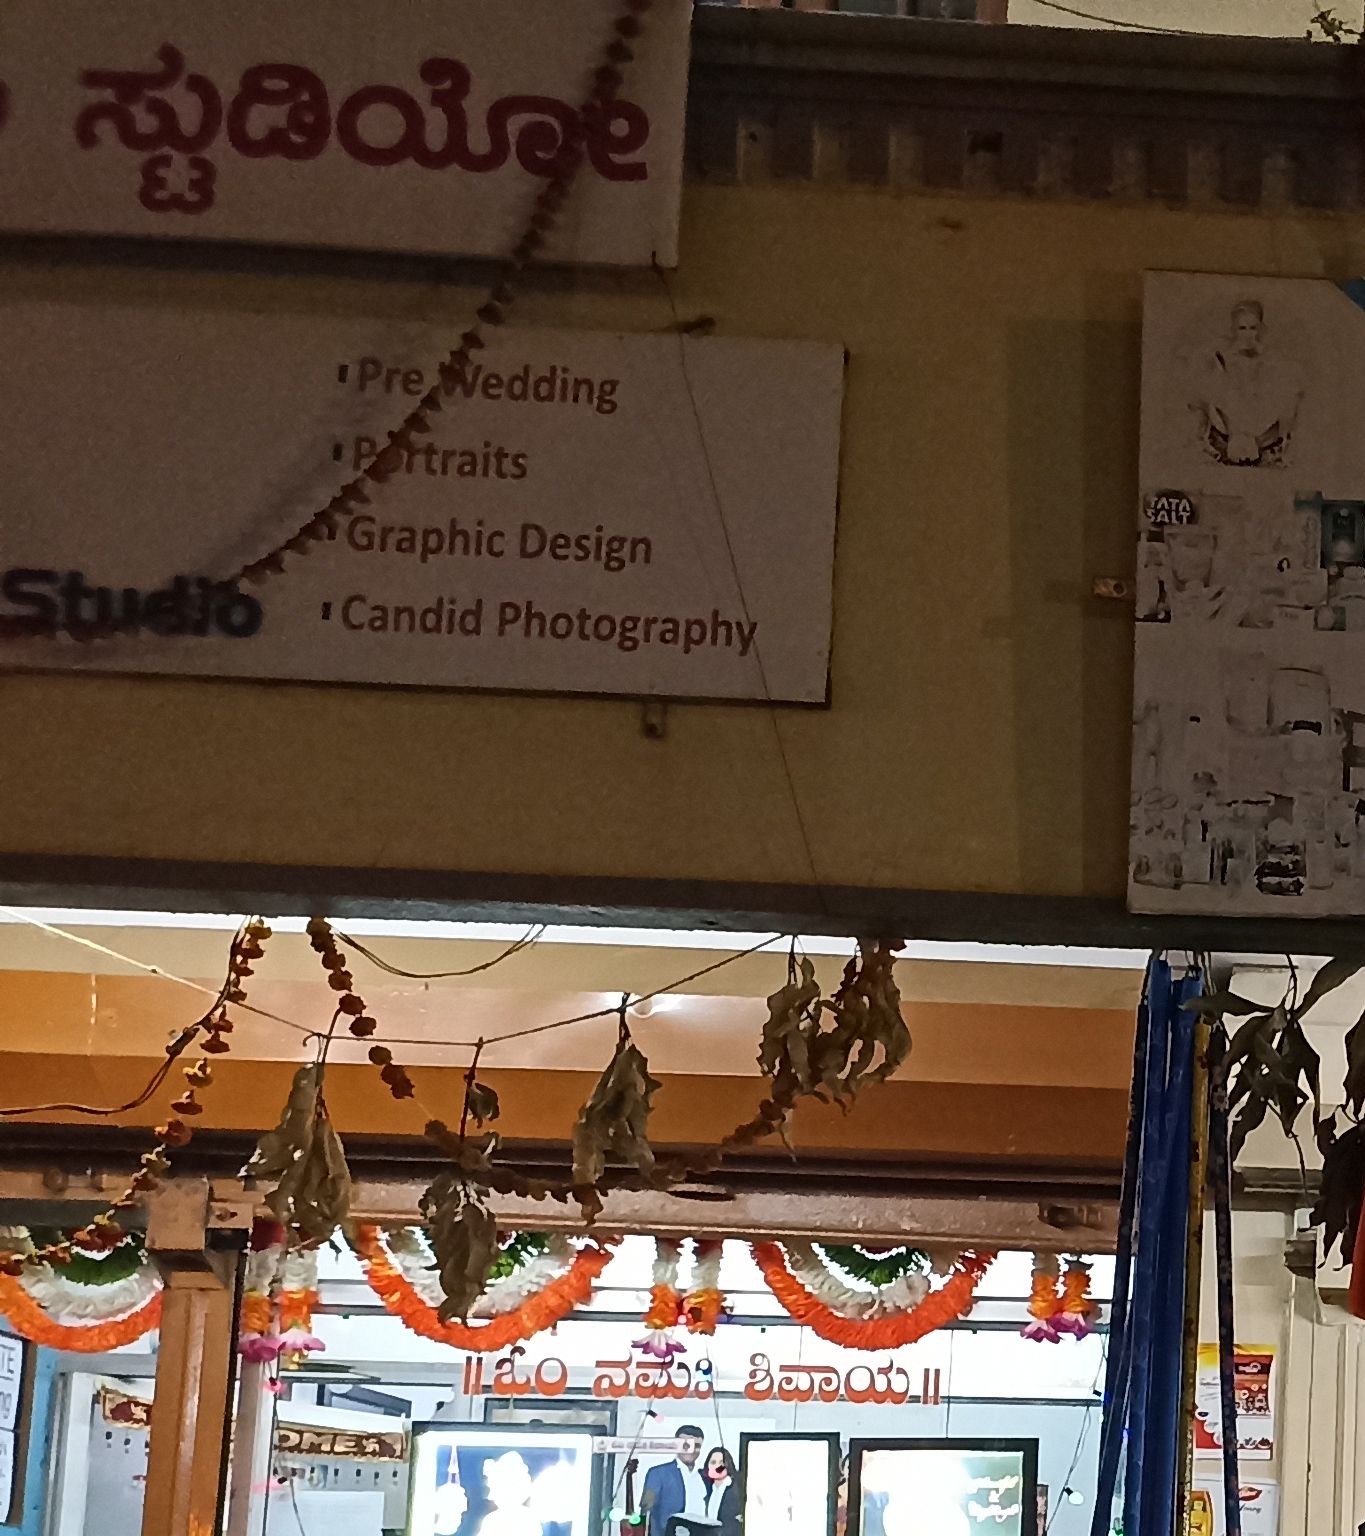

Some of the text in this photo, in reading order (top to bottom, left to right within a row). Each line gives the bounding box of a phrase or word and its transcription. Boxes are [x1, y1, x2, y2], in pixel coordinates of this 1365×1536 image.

[75, 43, 650, 213] ಸ್ಟುಡಿಯೋ
[358, 358, 619, 412] Pre Wedding
[347, 516, 653, 567] Graphic Design
[0, 568, 263, 640] Studio
[341, 595, 758, 654] Candid Photography
[744, 1352, 911, 1406] ಶಿವಾಯ
